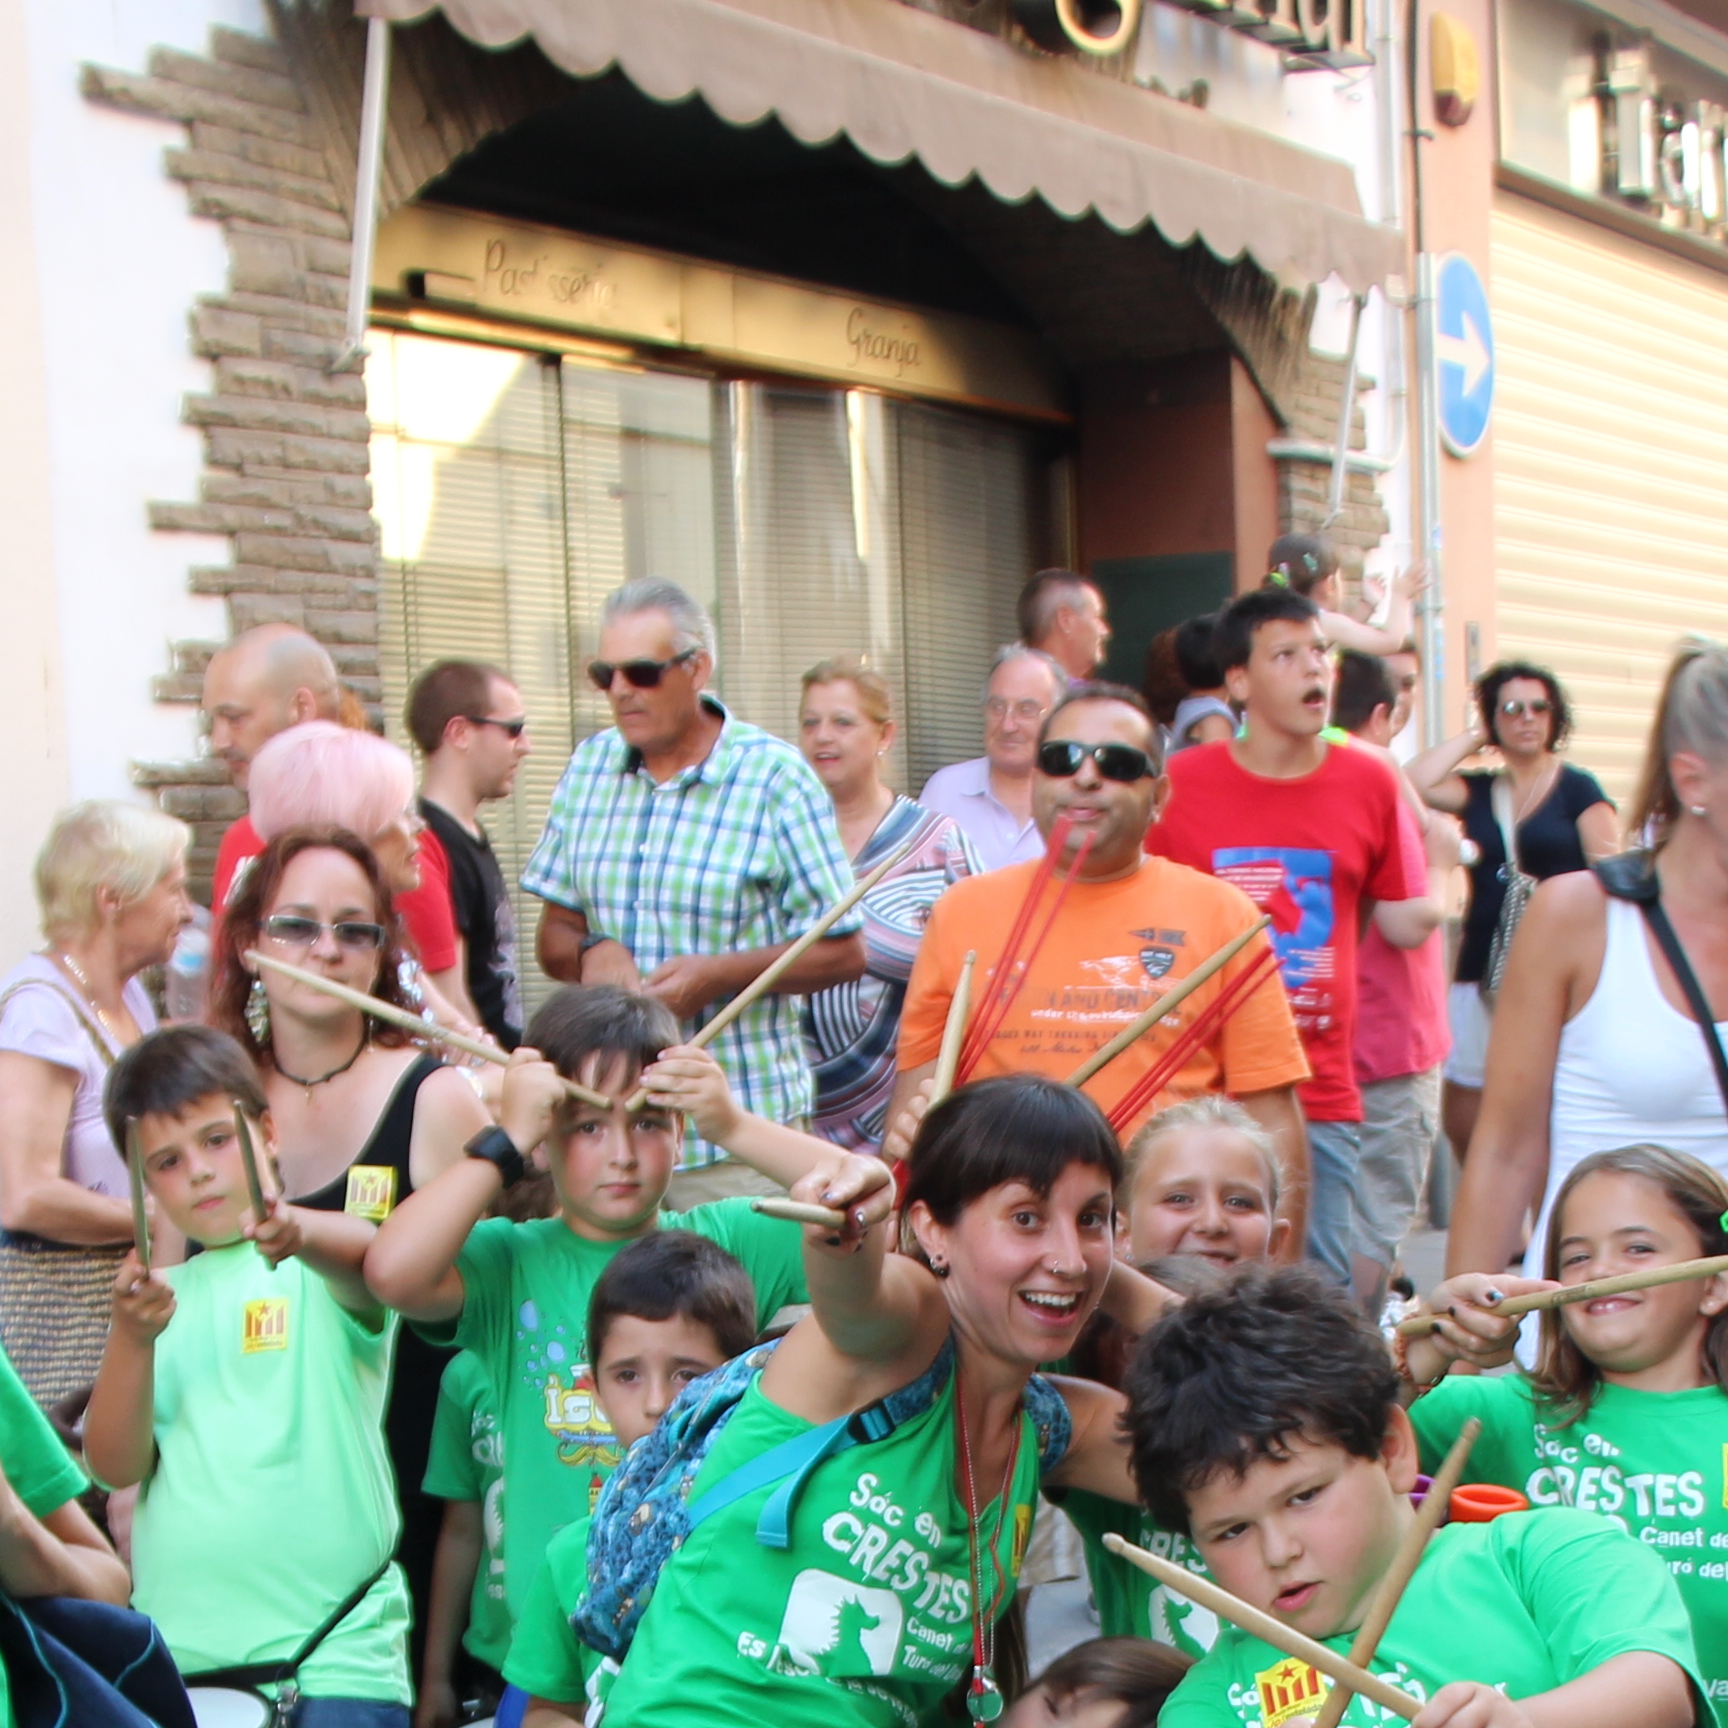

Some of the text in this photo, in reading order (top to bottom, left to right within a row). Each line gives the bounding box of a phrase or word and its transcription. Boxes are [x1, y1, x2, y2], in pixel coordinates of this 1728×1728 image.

[846, 306, 922, 378] Granja
[849, 1473, 942, 1549] Sóc en
[1639, 1526, 1704, 1549] Canet
[822, 1511, 971, 1624] CRESTES
[906, 1615, 955, 1652] Canet
